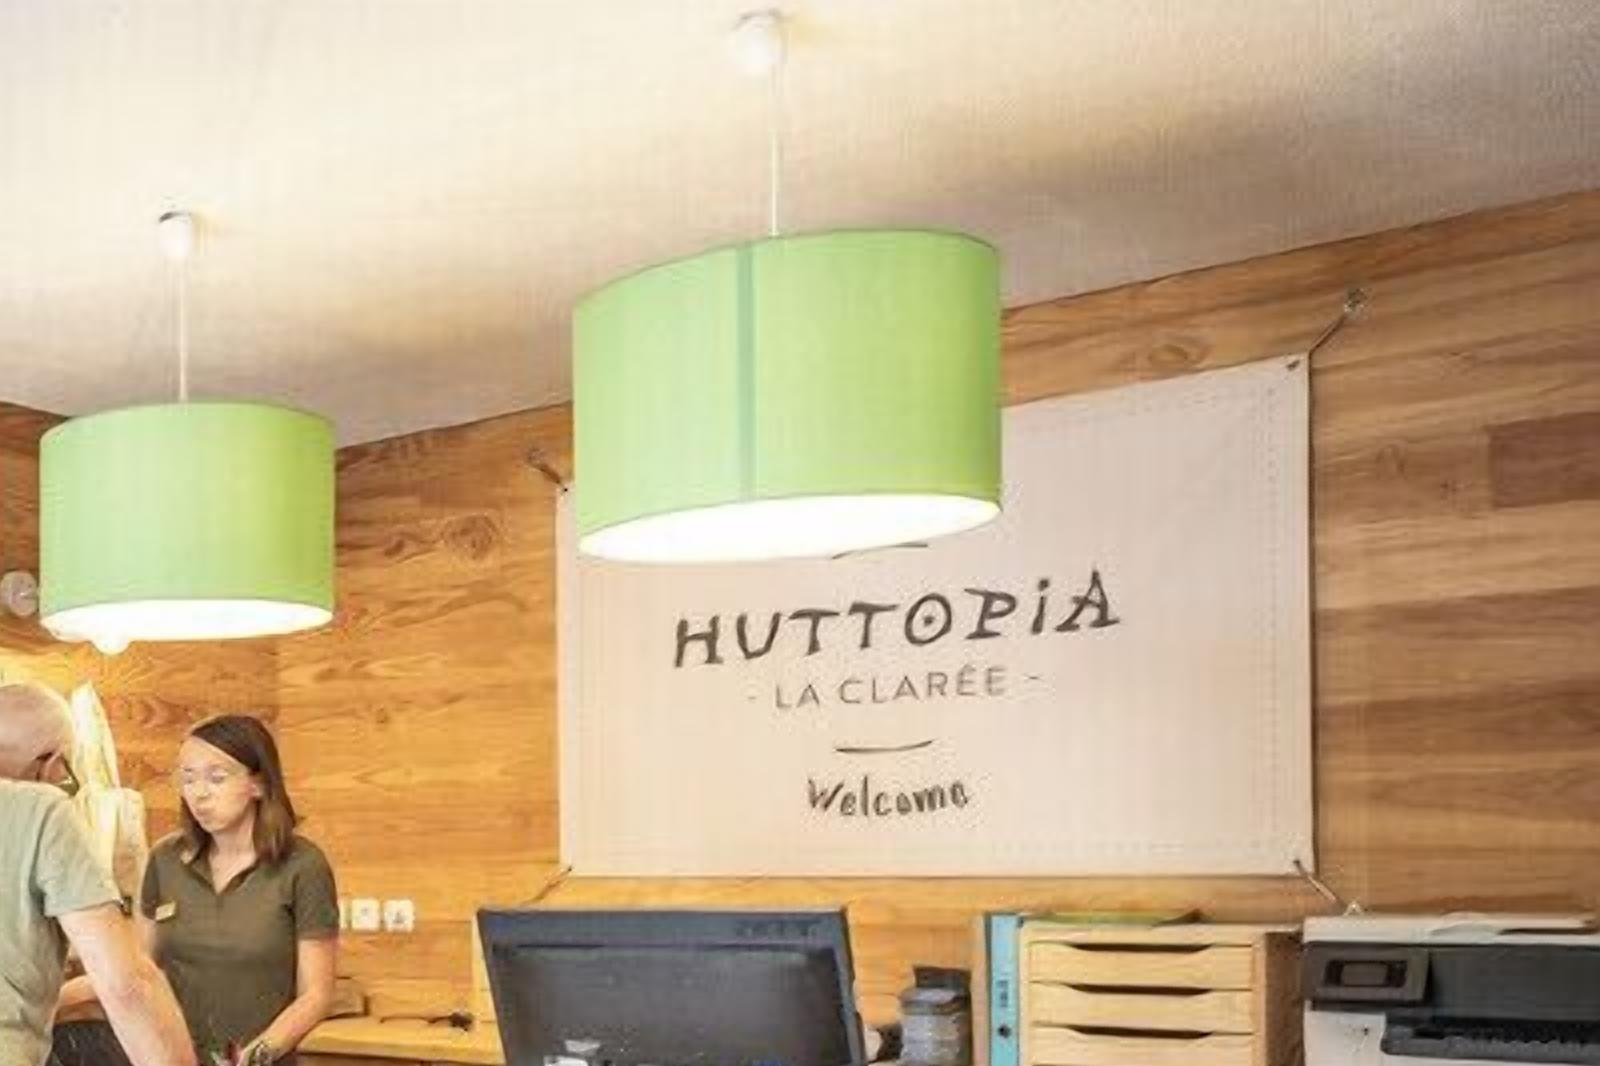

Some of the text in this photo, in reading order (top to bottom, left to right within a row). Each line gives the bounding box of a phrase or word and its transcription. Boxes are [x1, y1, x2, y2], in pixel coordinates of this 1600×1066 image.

[775, 662, 1008, 709] LA CLARÉE
[807, 774, 970, 817] Welcome
